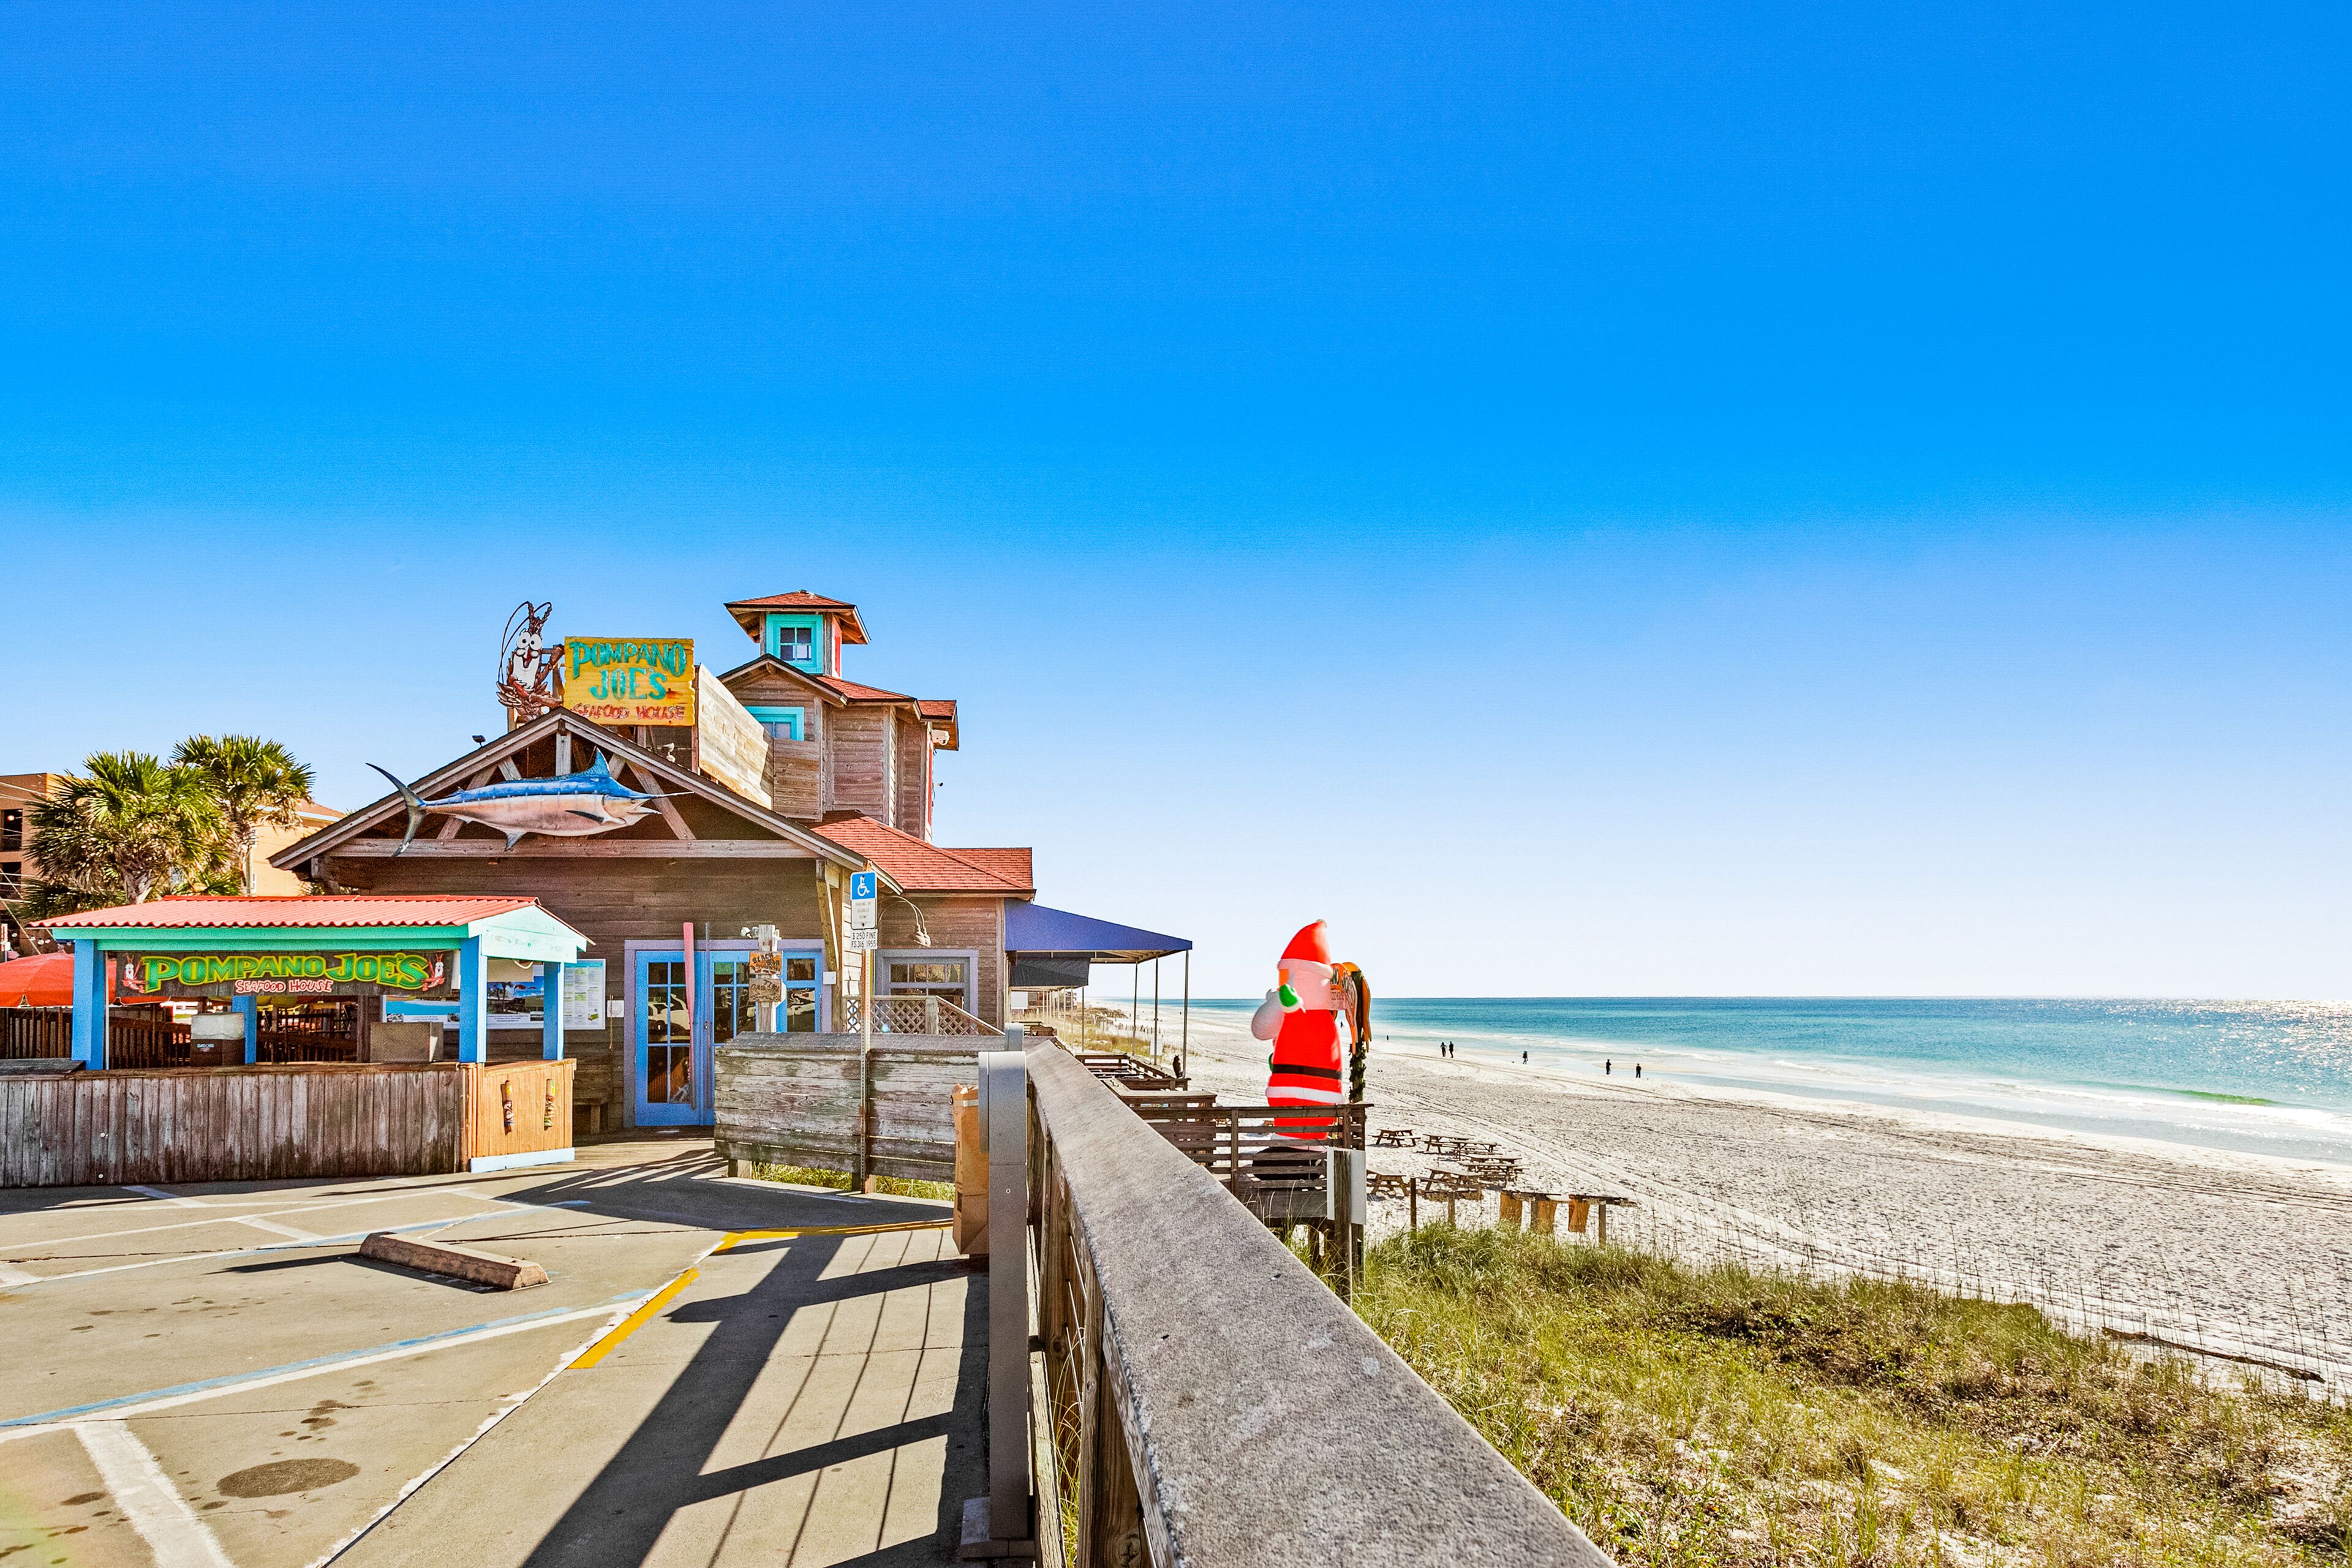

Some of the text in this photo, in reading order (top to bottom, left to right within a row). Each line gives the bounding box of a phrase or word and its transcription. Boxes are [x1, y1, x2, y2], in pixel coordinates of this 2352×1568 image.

[570, 642, 686, 679] POMPANO
[589, 667, 667, 700] JOE'S
[573, 703, 685, 720] SEAFOOD HOUSE
[141, 952, 429, 993] POMPANO JOE'S
[235, 979, 334, 993] SEAFOOD HOUSE
